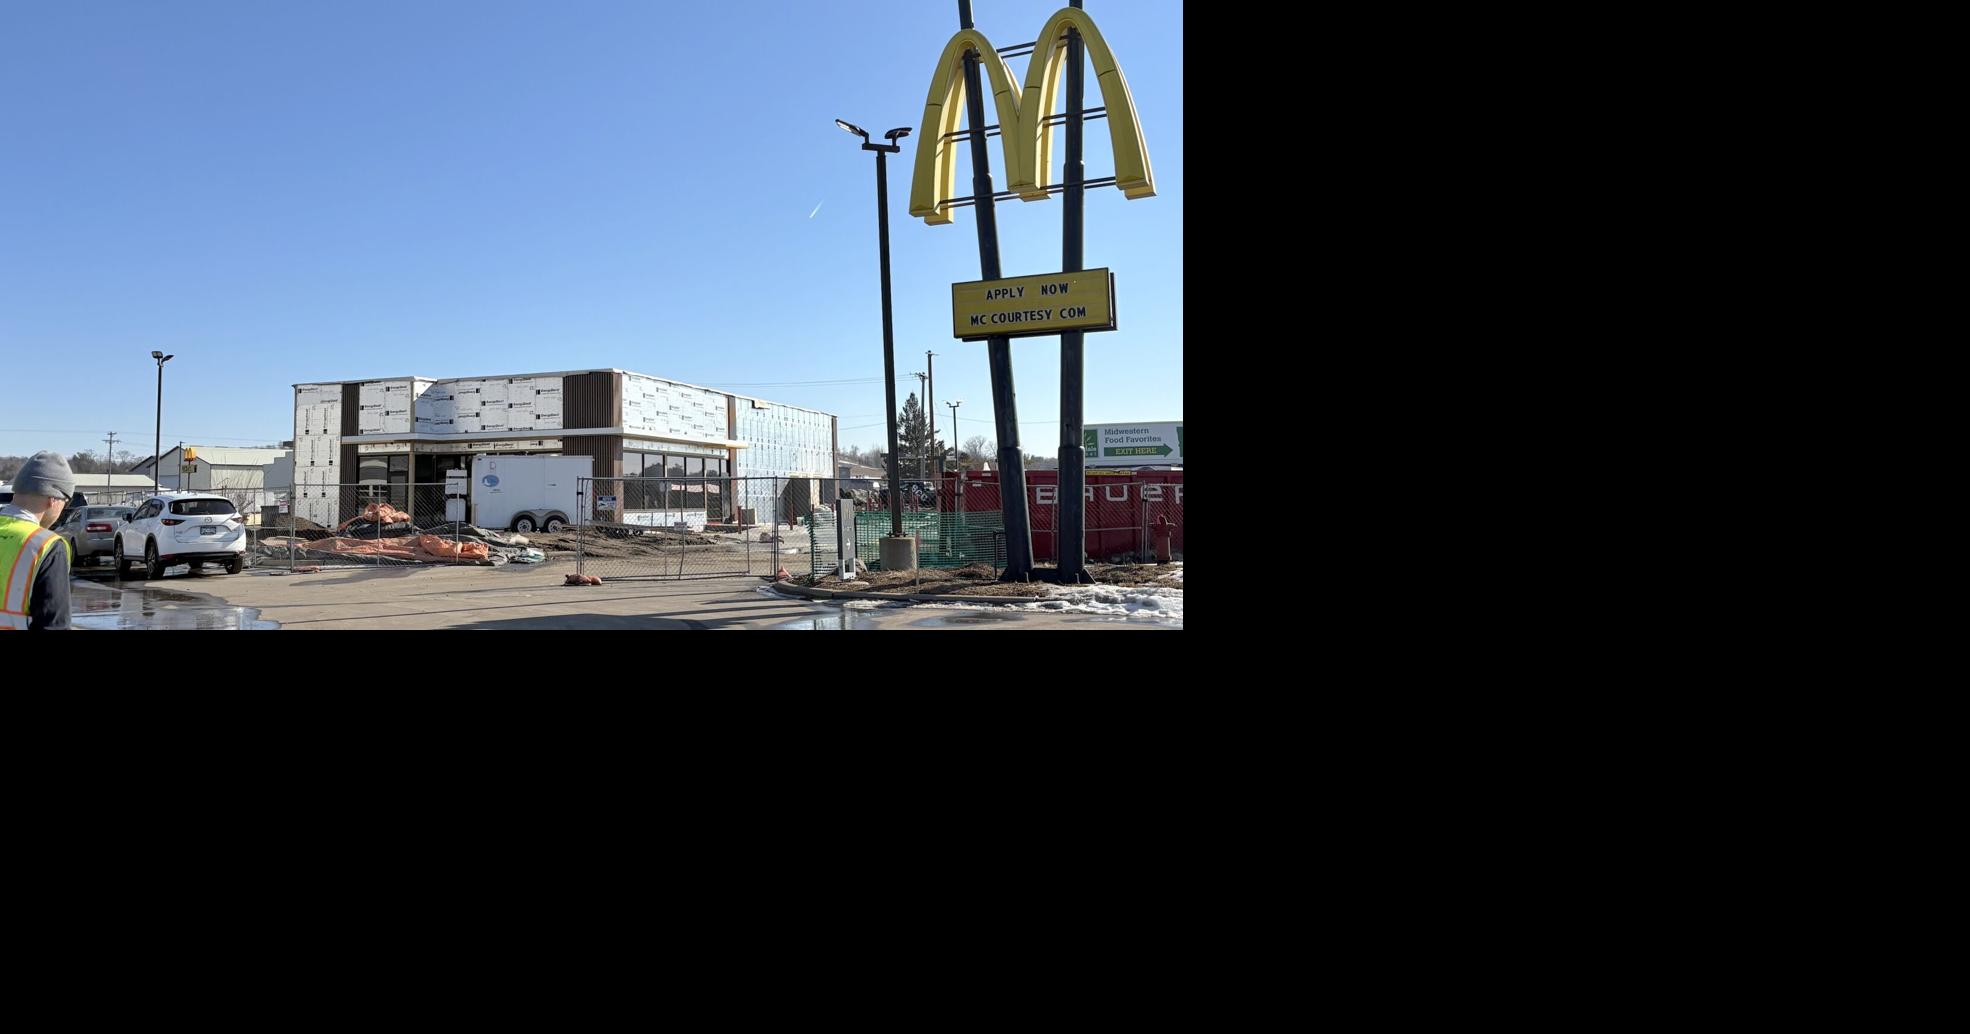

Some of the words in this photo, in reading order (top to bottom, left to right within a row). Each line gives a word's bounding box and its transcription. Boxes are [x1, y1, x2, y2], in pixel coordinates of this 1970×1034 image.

[986, 286, 1025, 301] APPLY
[1041, 282, 1069, 296] NOW
[970, 314, 986, 326] MC
[991, 309, 1052, 324] COURTESY
[1060, 306, 1086, 319] COM
[1104, 428, 1149, 436] Midwestern
[1126, 435, 1161, 443] Favorites
